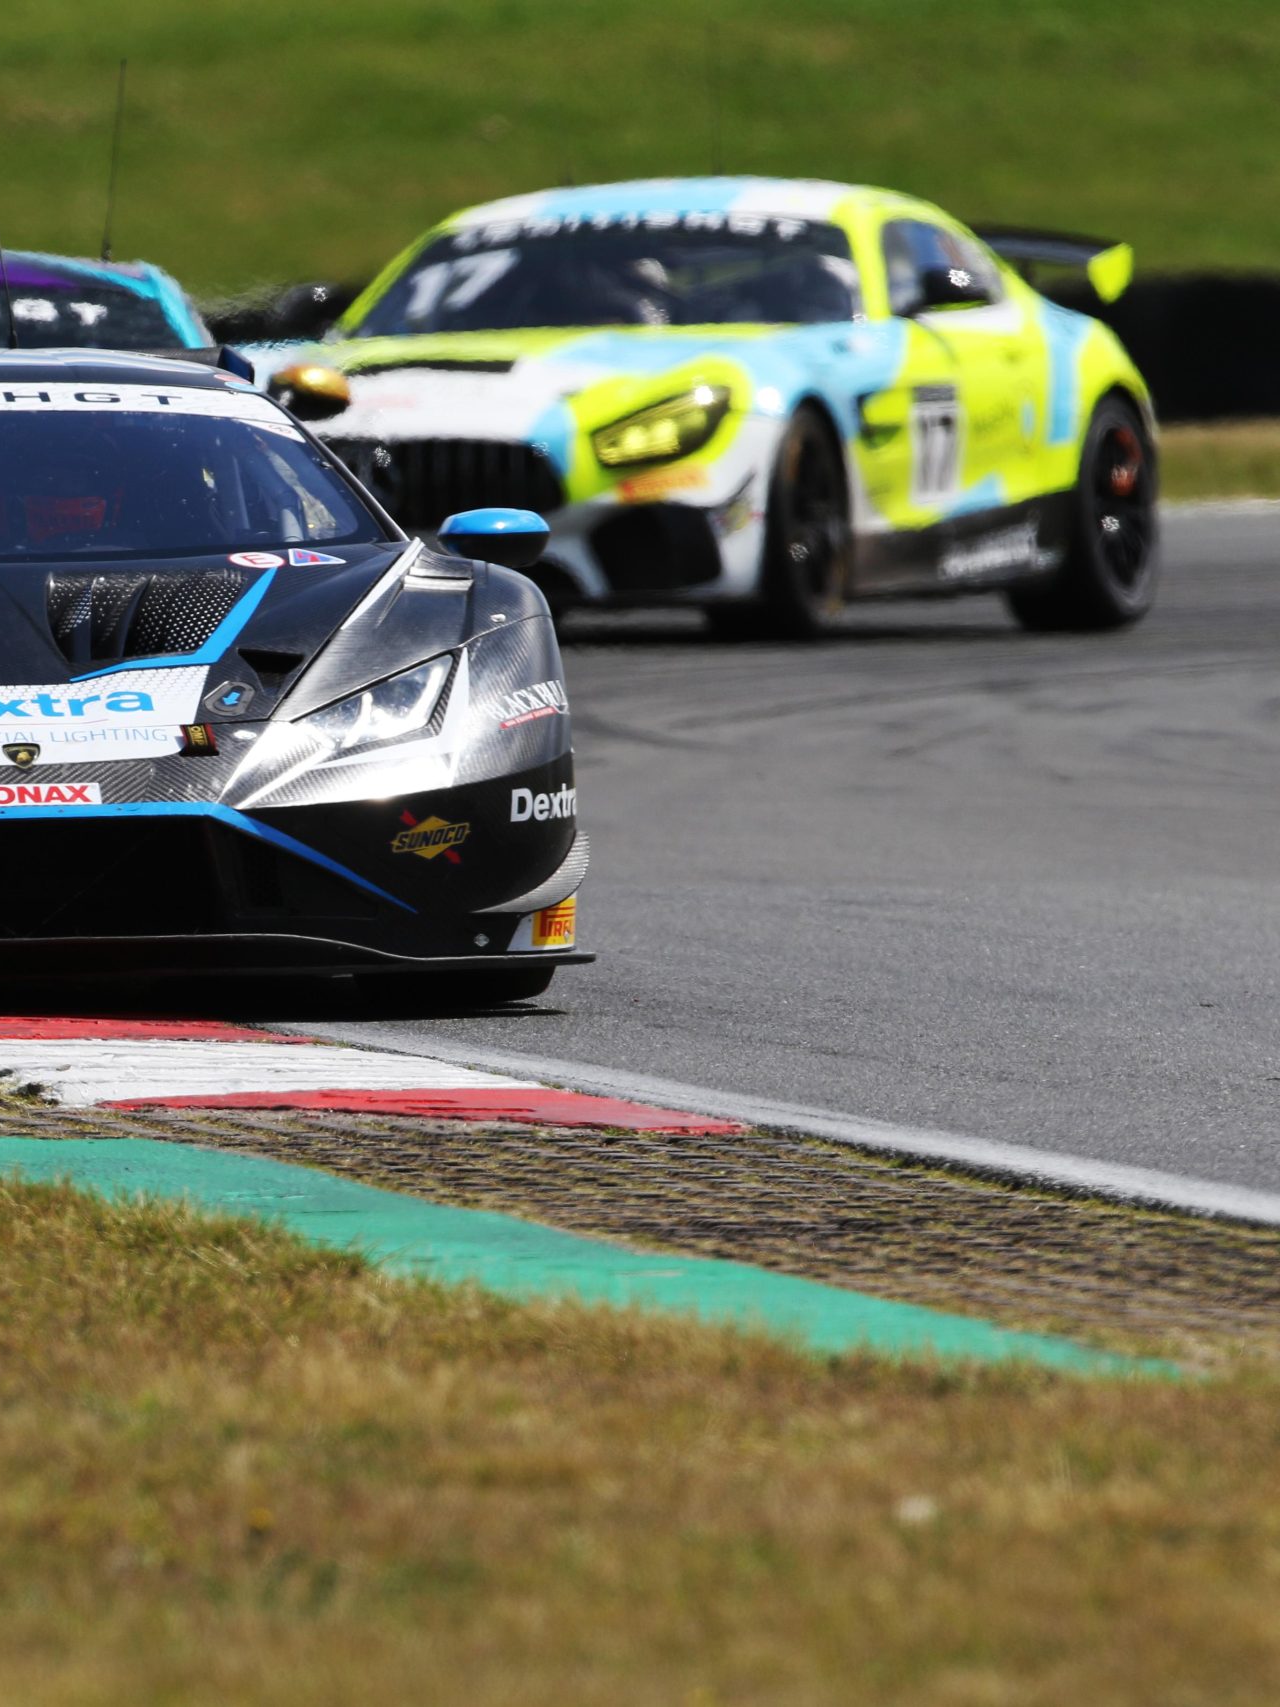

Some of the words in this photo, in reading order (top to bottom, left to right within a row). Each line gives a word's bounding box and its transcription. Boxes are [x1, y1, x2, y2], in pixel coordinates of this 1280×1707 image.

[406, 248, 516, 322] 17
[49, 727, 168, 745] LIGHTING
[395, 825, 468, 850] SUNOCO
